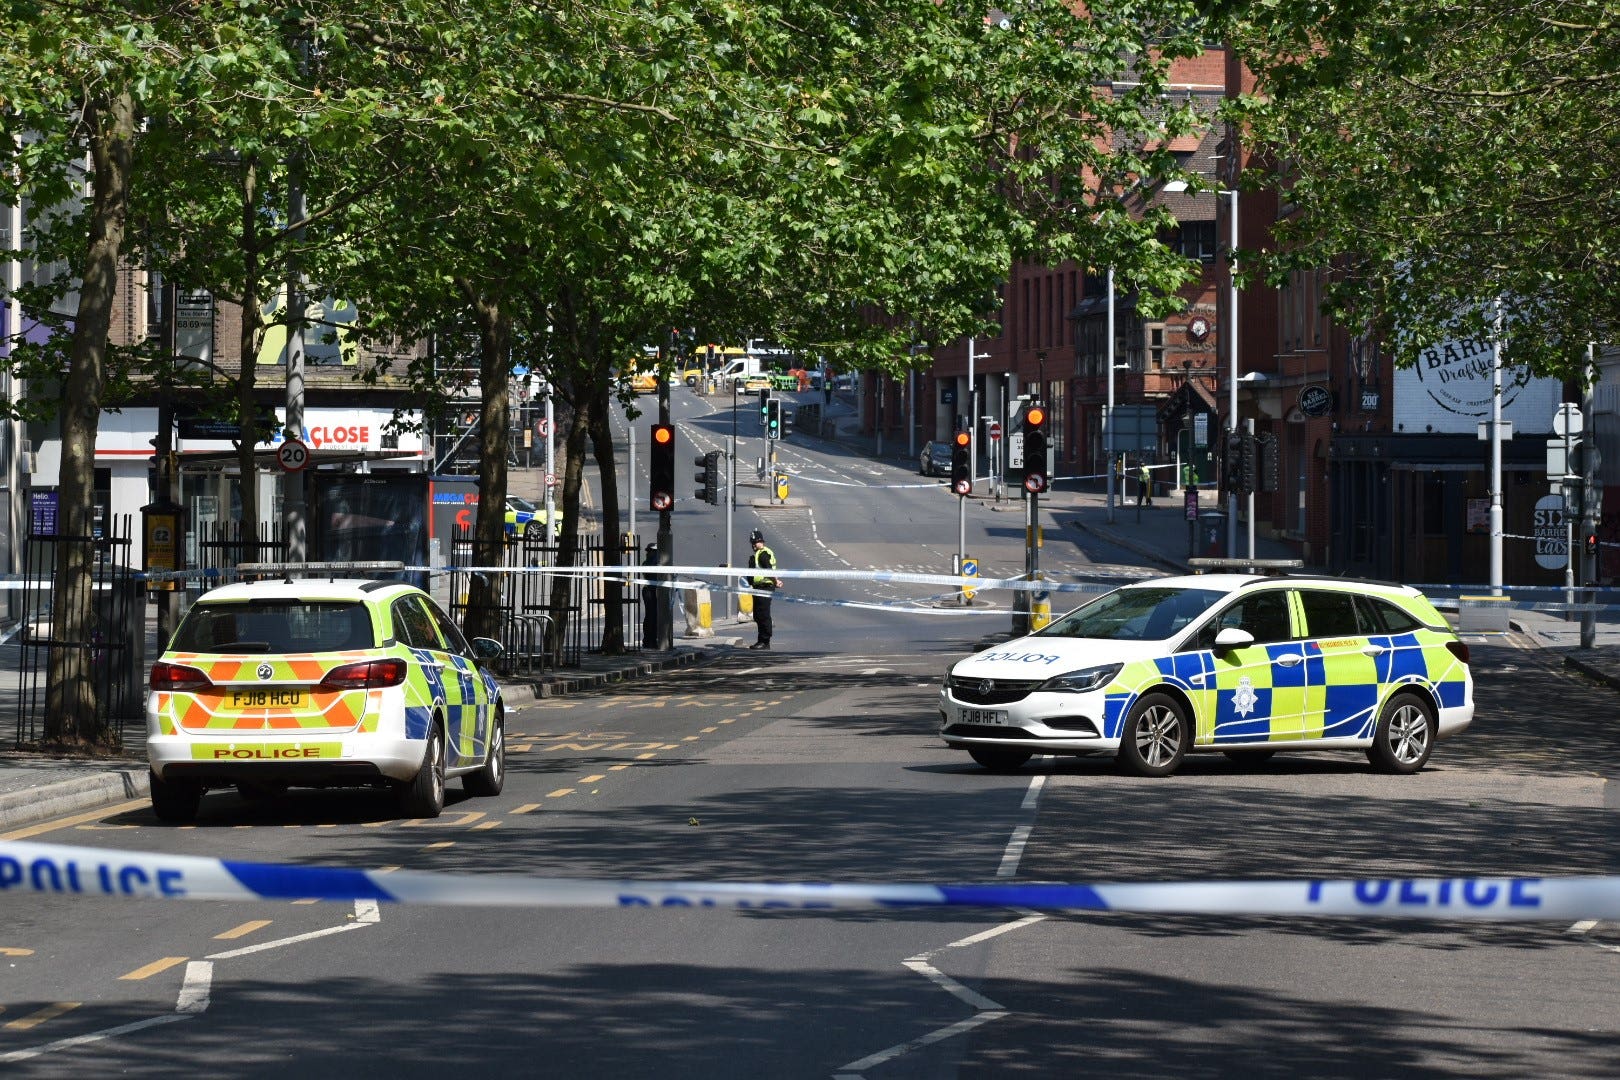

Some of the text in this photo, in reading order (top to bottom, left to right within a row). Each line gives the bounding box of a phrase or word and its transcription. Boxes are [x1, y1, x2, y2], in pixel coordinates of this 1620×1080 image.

[1362, 395, 1377, 406] 200
[282, 448, 305, 463] 20
[546, 475, 555, 483] 20
[233, 686, 300, 706] FJ18 HCU
[962, 710, 1001, 724] FJ18 HFL
[214, 748, 321, 759] POLICE
